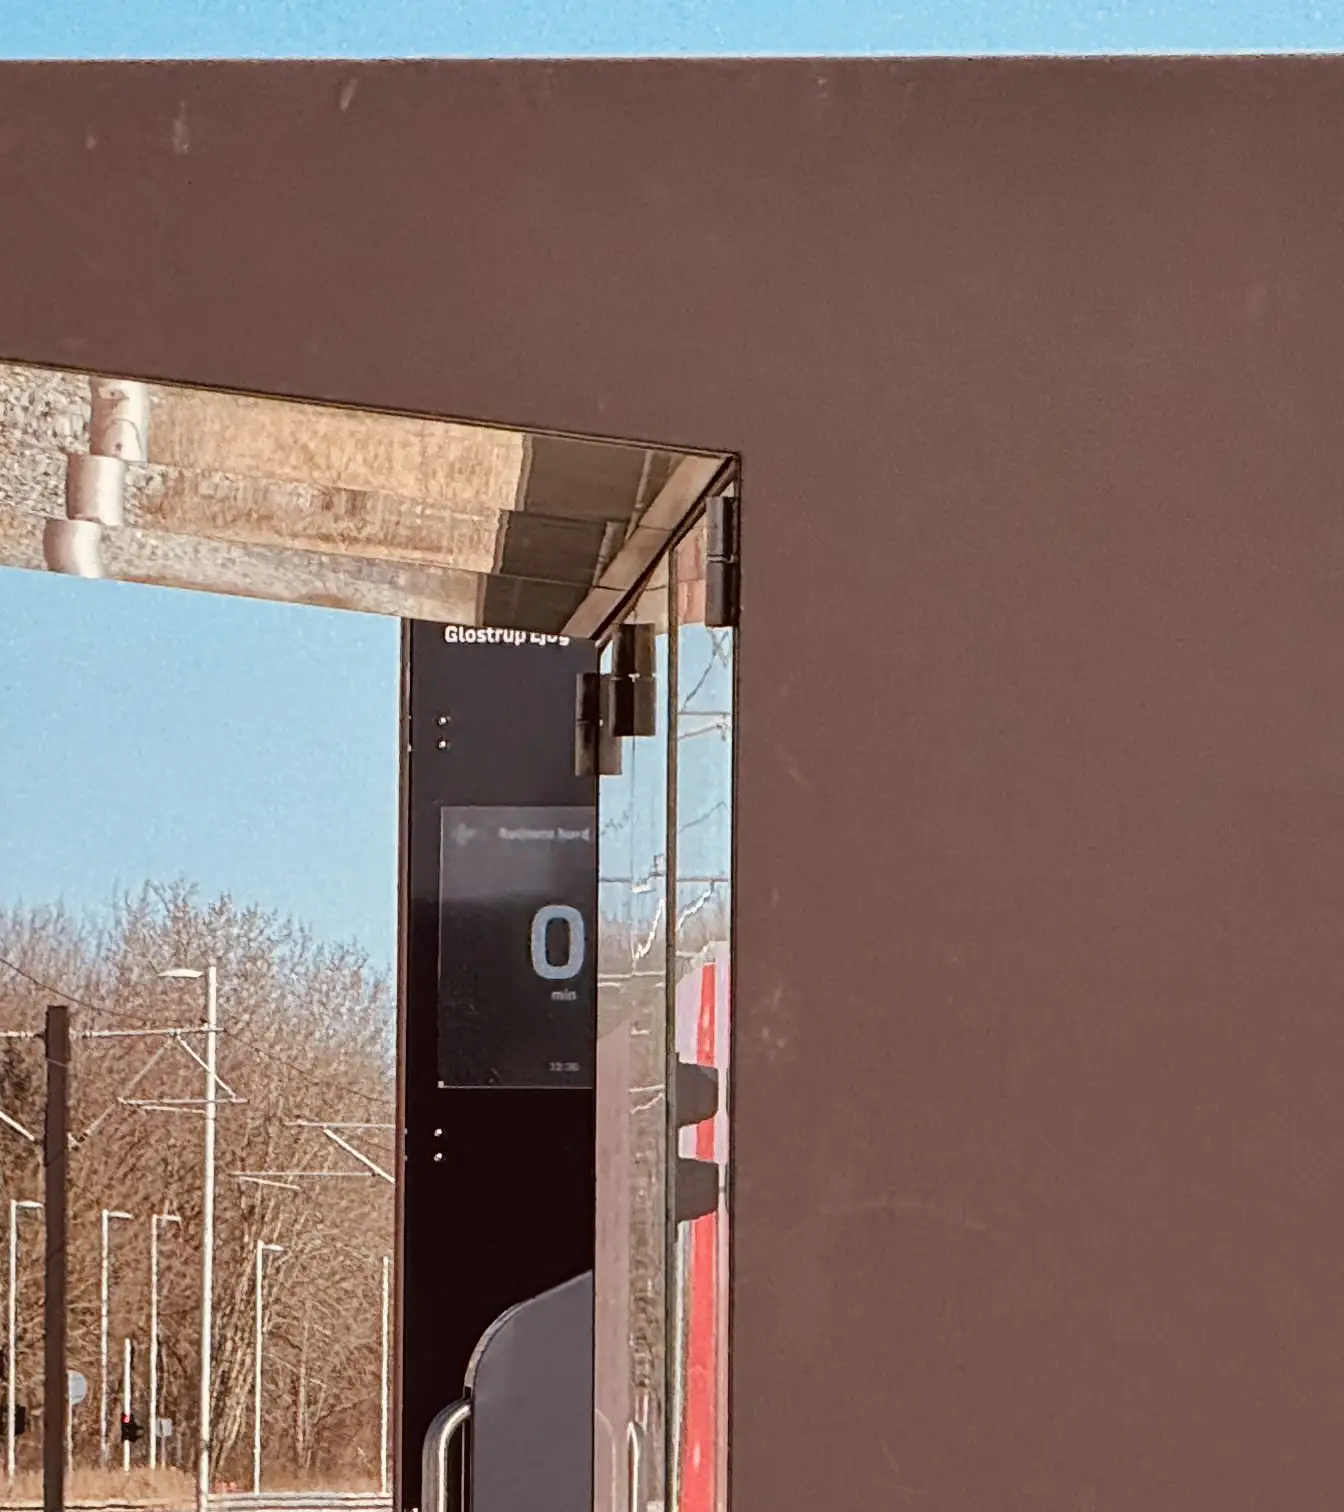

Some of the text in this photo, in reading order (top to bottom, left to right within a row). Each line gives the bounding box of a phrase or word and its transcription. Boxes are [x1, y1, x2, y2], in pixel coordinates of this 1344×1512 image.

[444, 625, 526, 646] Glostrup
[531, 904, 585, 980] 0
[551, 989, 577, 1001] min
